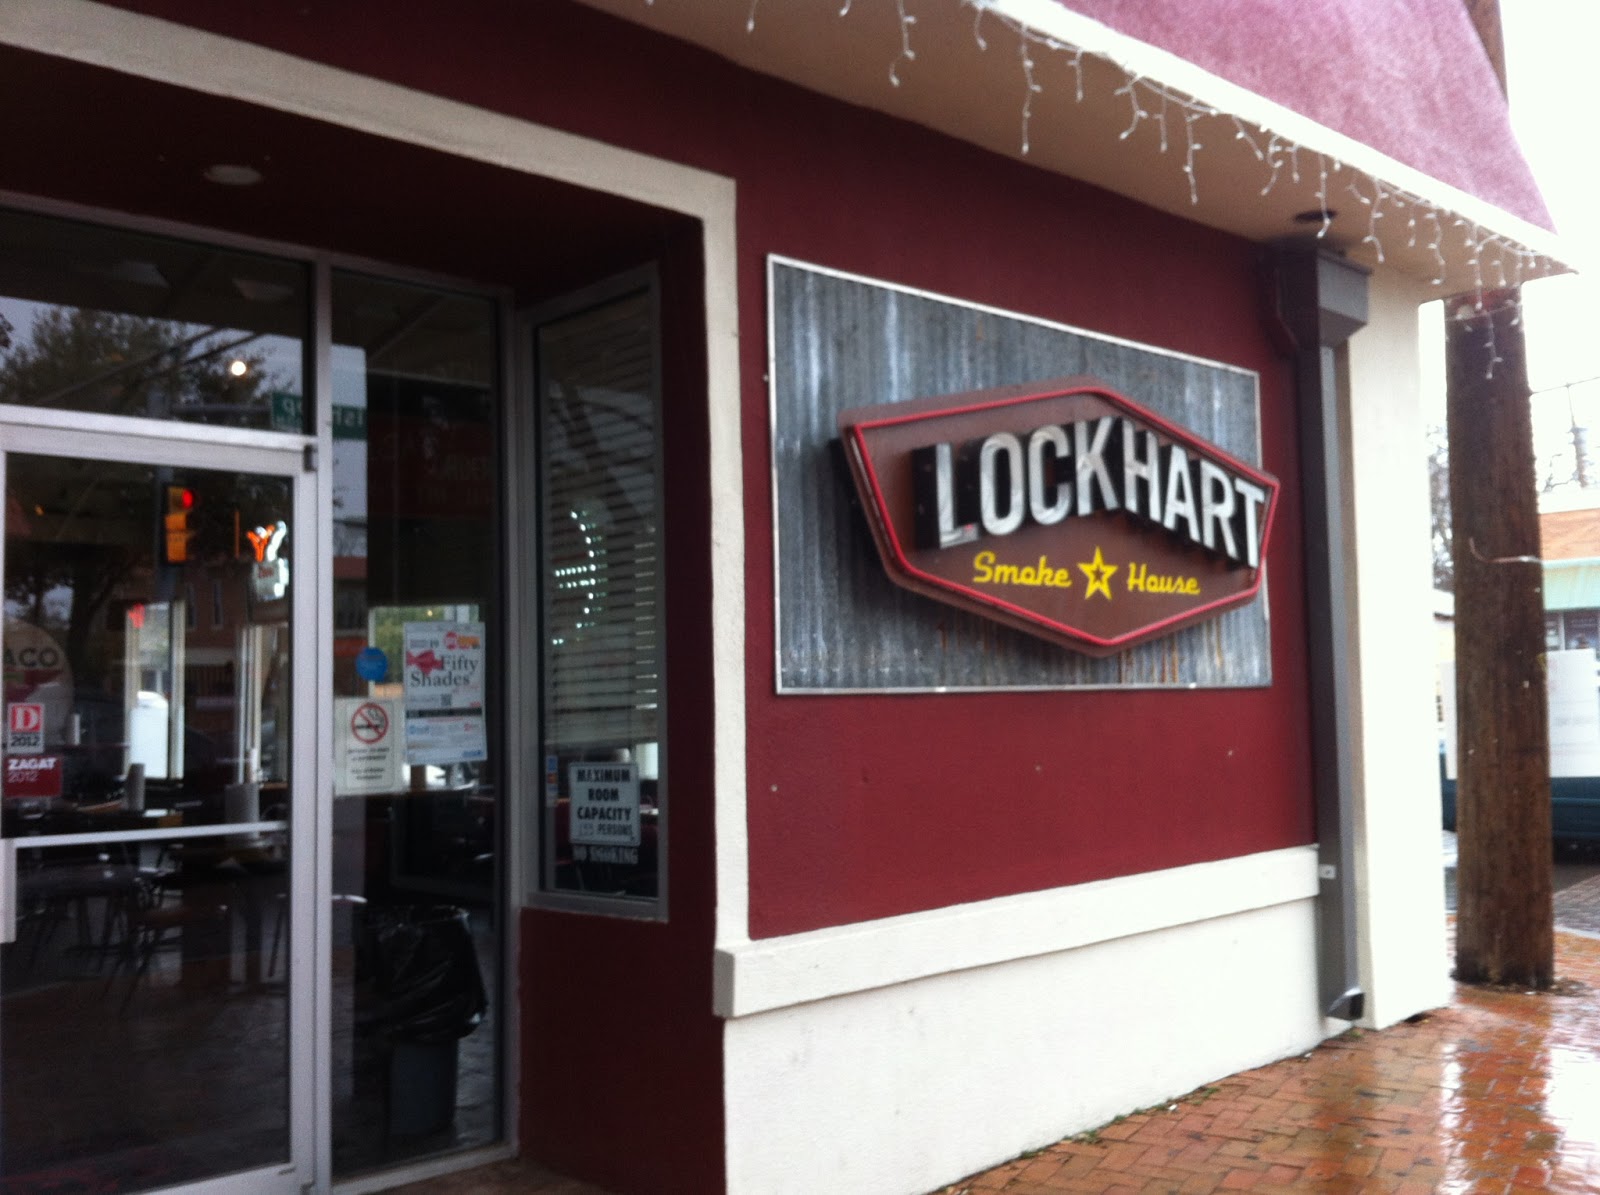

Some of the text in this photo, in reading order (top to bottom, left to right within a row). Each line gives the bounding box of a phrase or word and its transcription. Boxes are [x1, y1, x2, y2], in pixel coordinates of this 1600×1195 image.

[934, 415, 1265, 568] LOCKHART
[973, 550, 1201, 595] Smoke House
[441, 653, 479, 673] Fifty
[410, 671, 470, 687] Shades
[14, 706, 38, 731] D
[11, 736, 40, 746] 2012
[8, 757, 58, 770] ZAGAT
[8, 770, 39, 783] 2012
[577, 768, 631, 783] MAXIMUM
[587, 787, 620, 802] ROOM
[577, 806, 632, 821] CAPACITY
